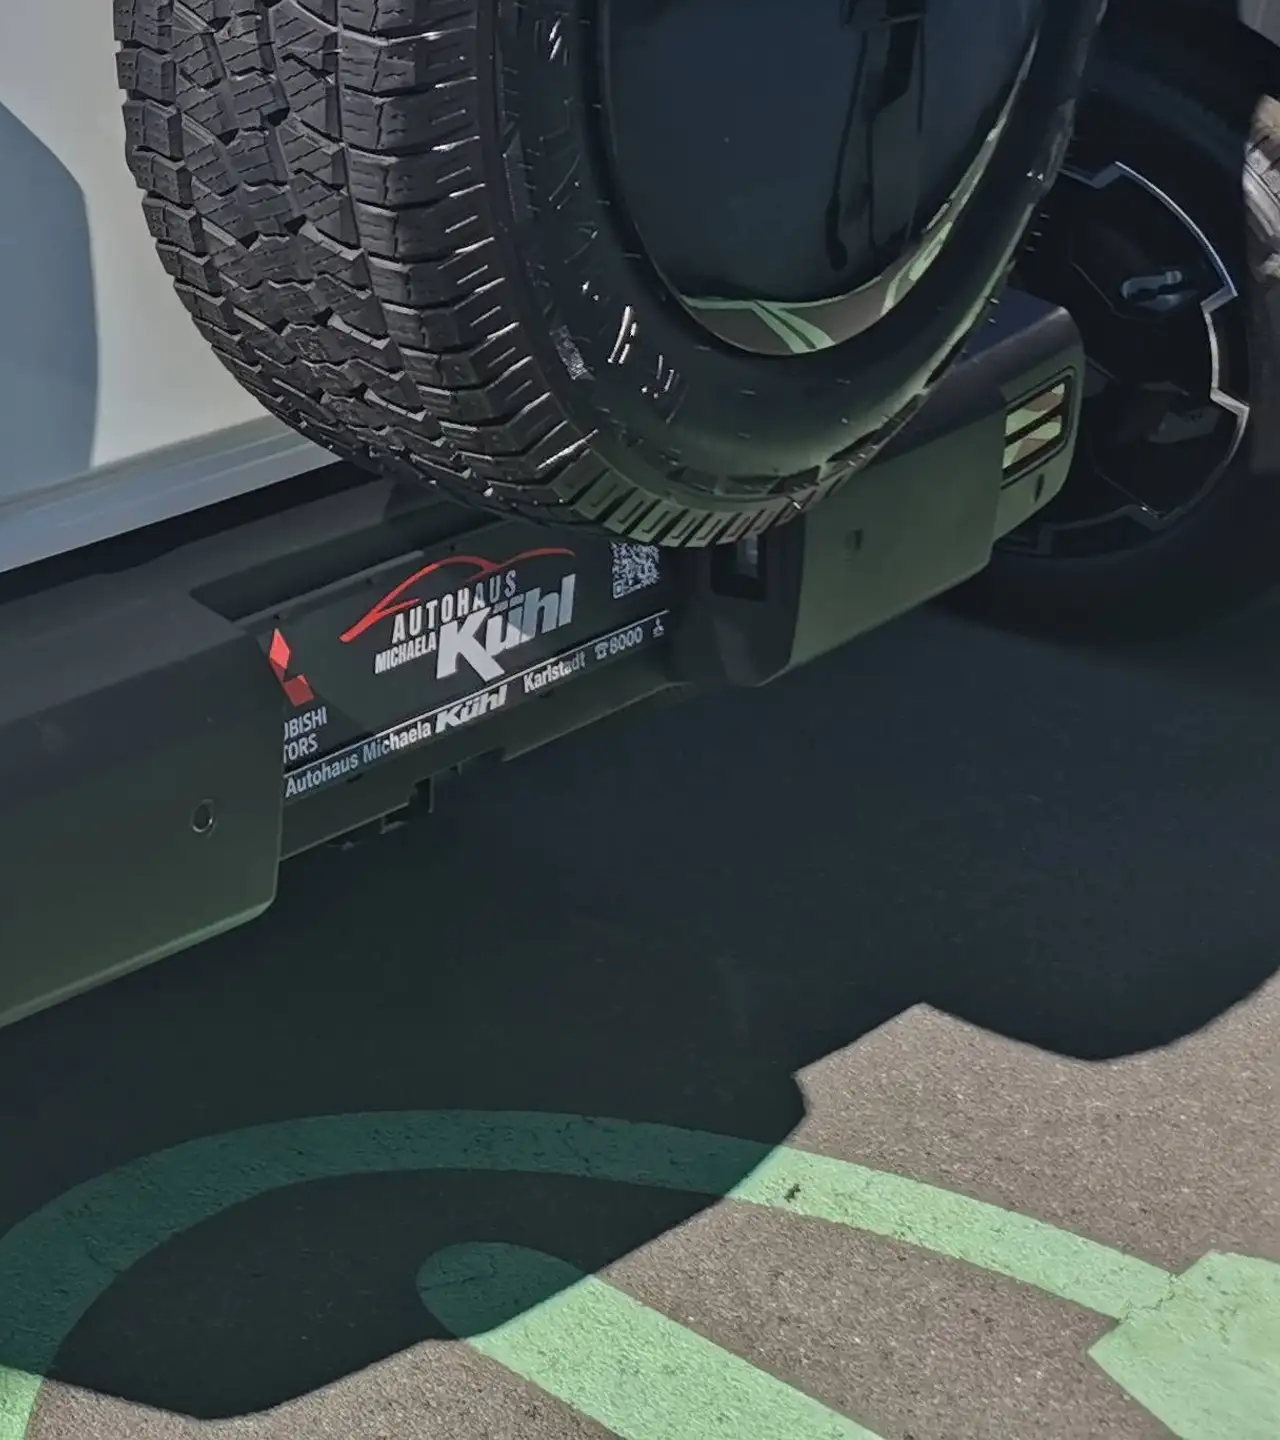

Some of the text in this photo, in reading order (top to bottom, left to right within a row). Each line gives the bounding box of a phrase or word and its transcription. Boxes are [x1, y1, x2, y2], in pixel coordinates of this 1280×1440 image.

[391, 569, 517, 645] AUTOHAUS
[375, 631, 437, 675] MICHAELA
[285, 751, 359, 799] Autohaus
[362, 721, 432, 764] Michaela
[435, 684, 508, 734] Kühl
[522, 650, 586, 694] Karlstadt
